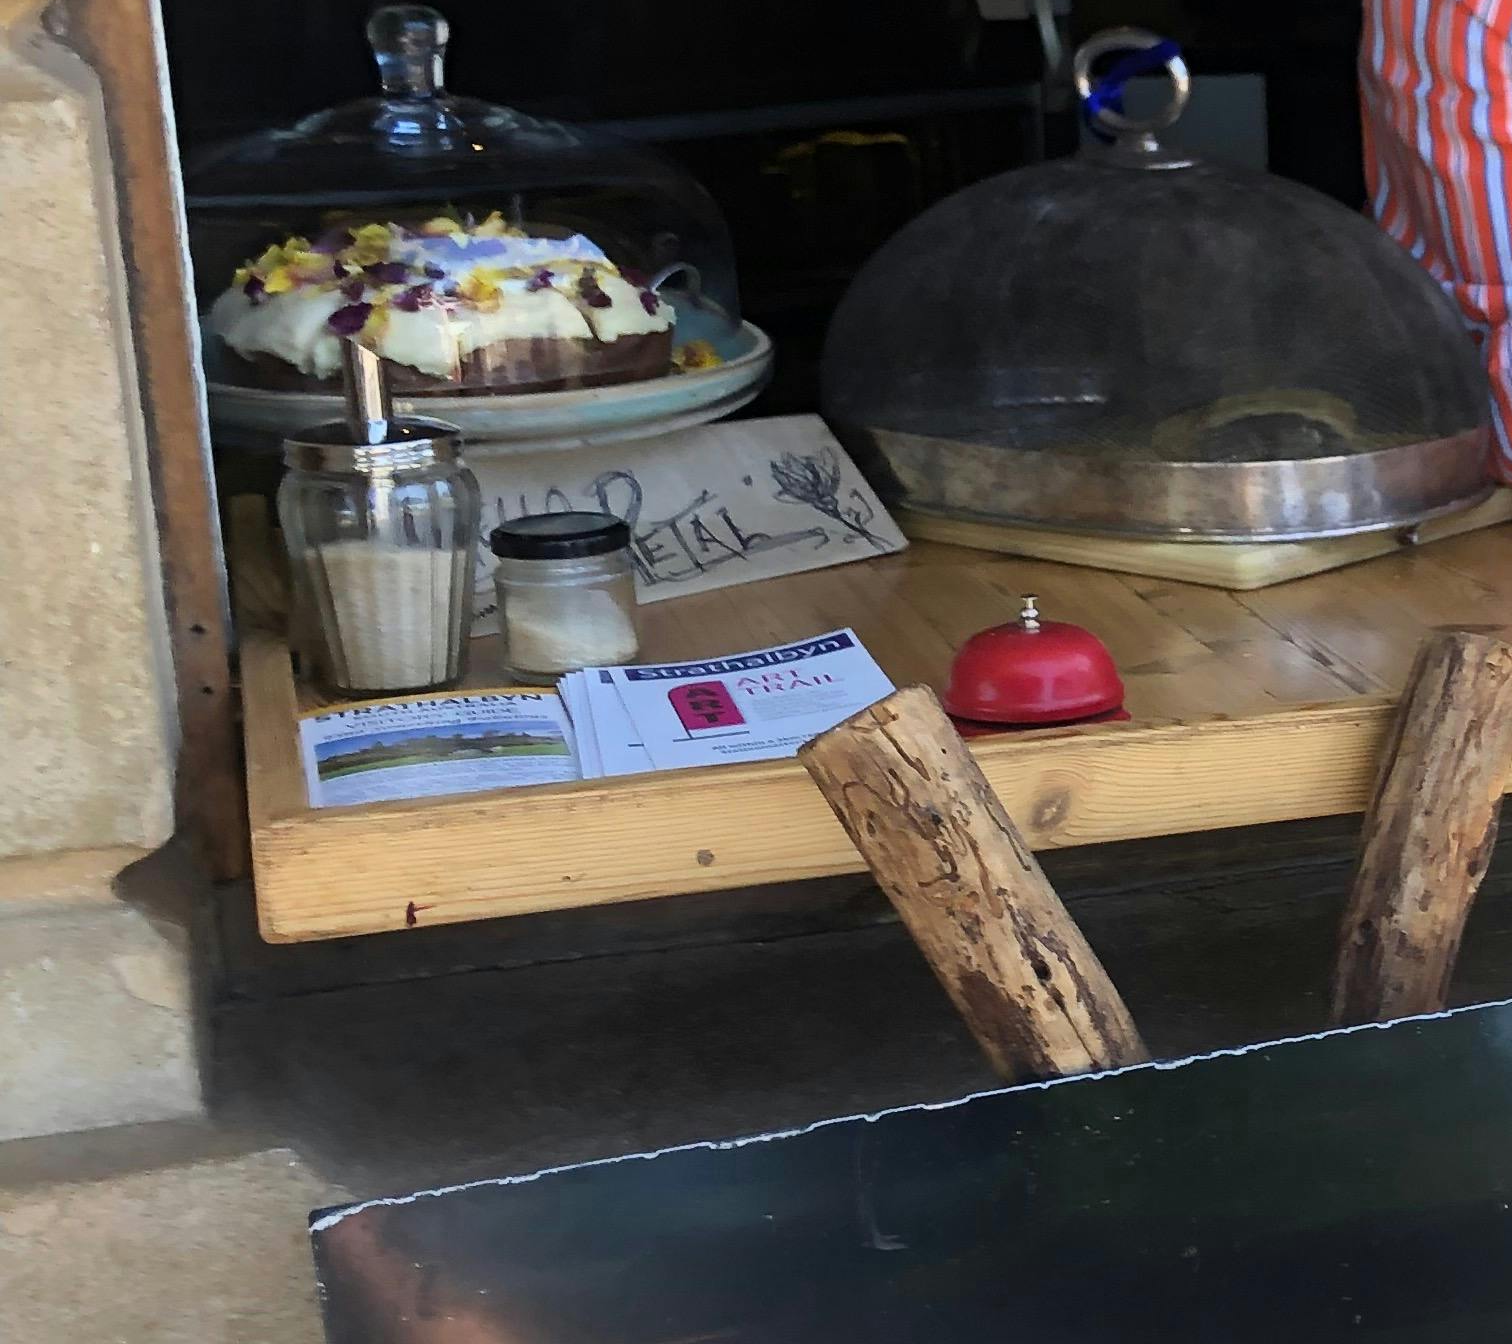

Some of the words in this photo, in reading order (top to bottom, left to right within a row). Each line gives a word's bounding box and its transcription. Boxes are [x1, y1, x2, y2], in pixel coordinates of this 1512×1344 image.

[637, 639, 841, 677] Strathalbyn
[737, 670, 798, 687] ART
[741, 673, 844, 696] TRAIL
